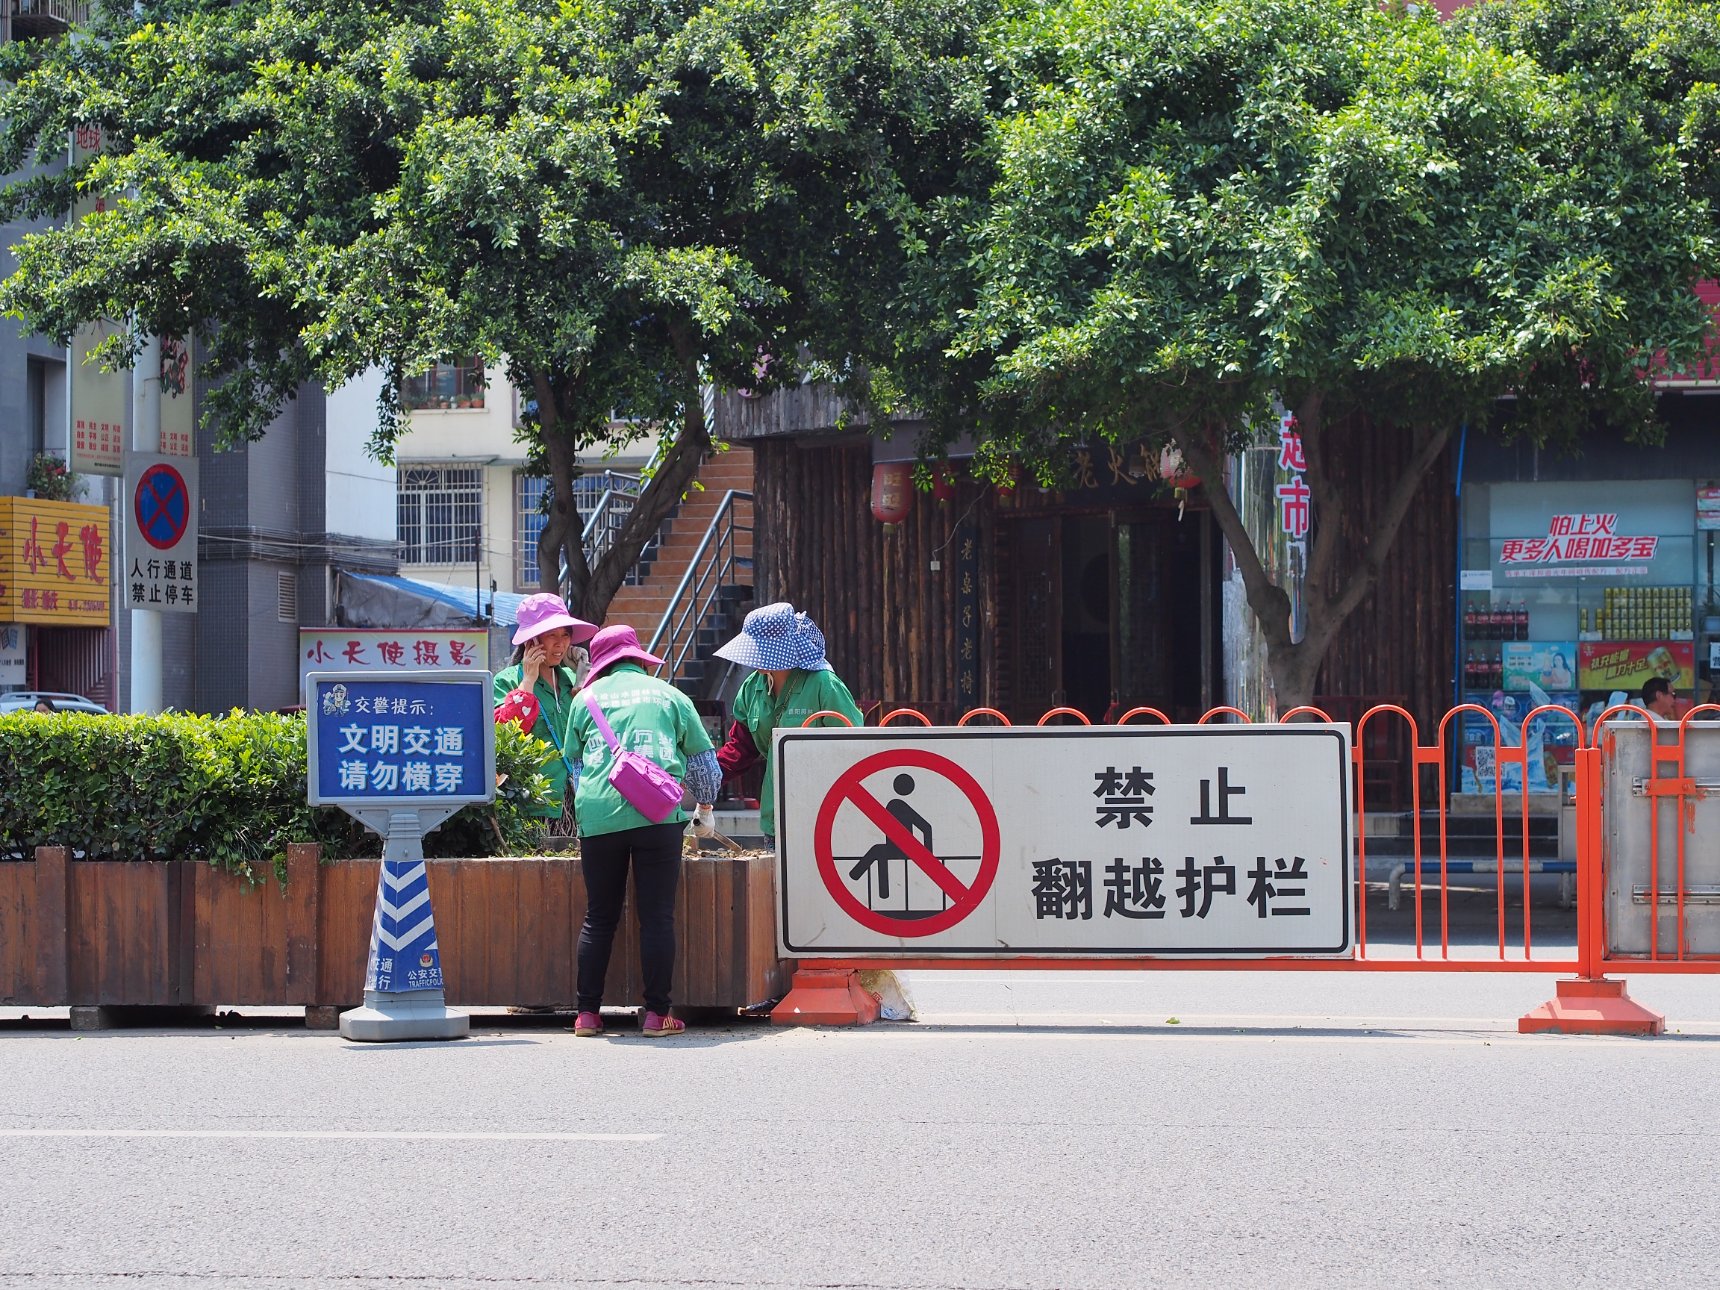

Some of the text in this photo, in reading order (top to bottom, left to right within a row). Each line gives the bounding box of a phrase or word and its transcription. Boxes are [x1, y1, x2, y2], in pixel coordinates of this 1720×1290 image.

[1550, 514, 1615, 537] 怕上火
[23, 514, 105, 583] 小天使
[1502, 537, 1657, 561] 更多人喝加多宝
[131, 557, 193, 581] 人行通道
[131, 582, 194, 606] 禁止停车
[307, 639, 477, 667] 小天使摄影
[338, 723, 465, 757] 文明交通
[338, 759, 464, 794] 请勿横穿
[1094, 766, 1253, 830] 禁止
[1031, 857, 1311, 921] 翻越护栏
